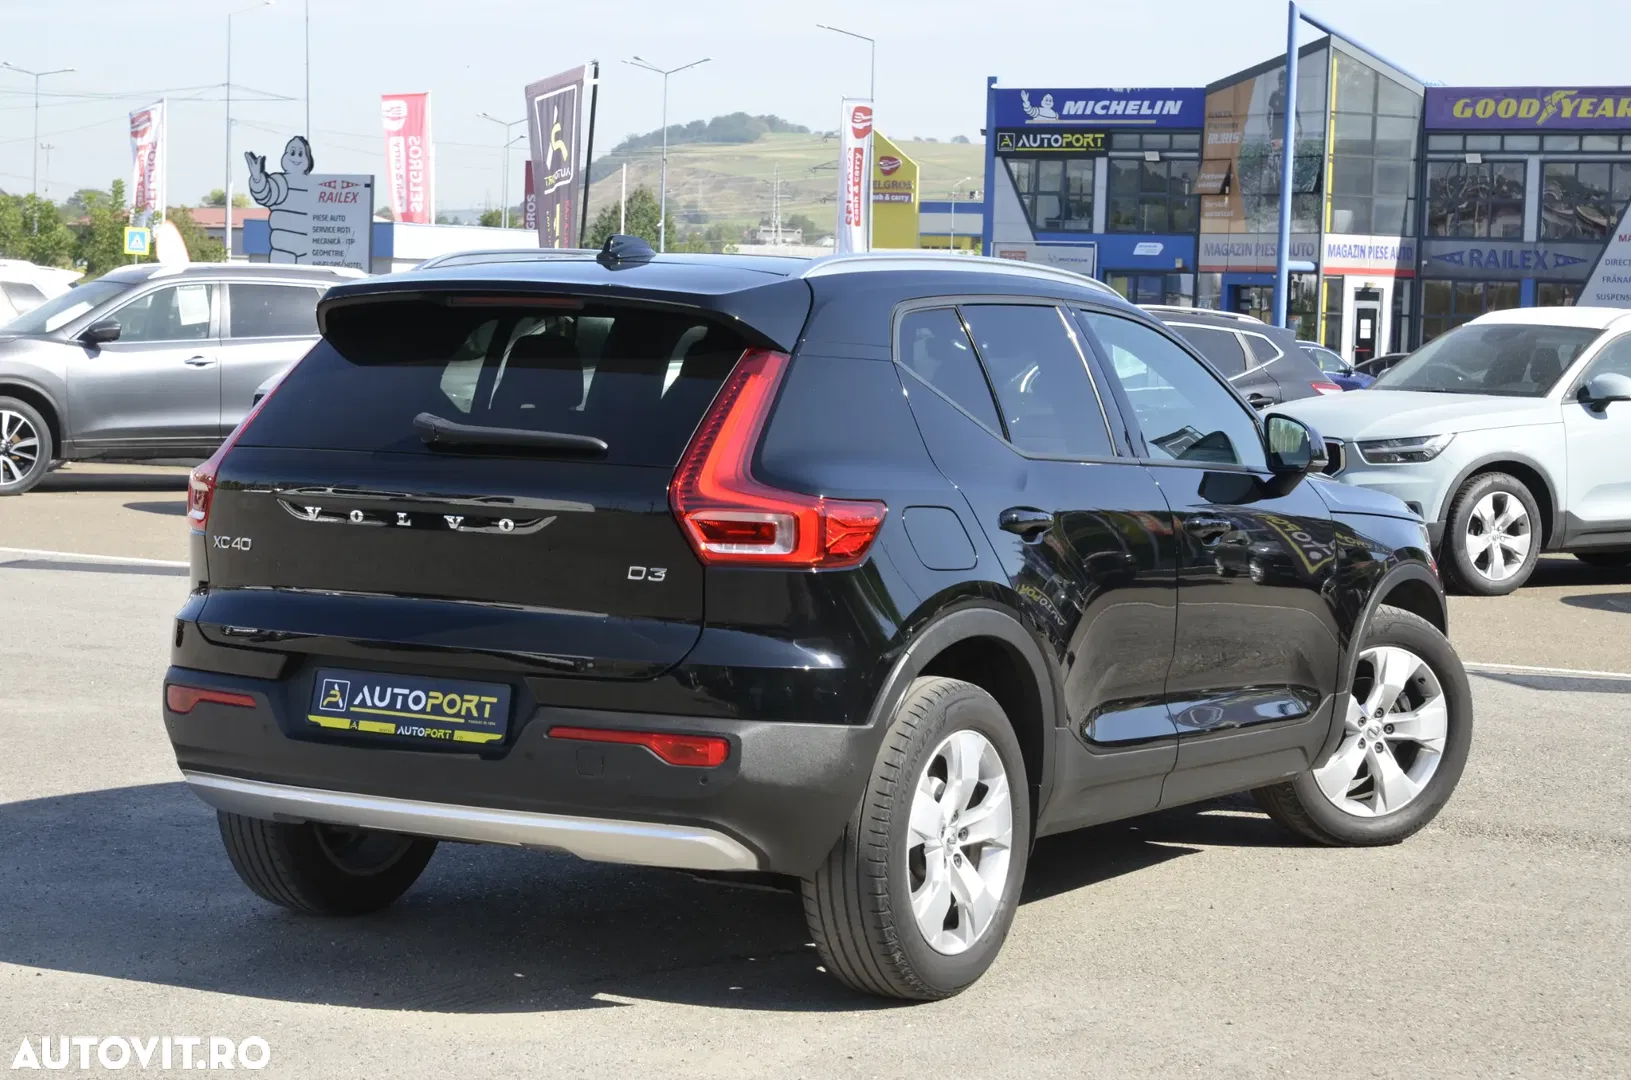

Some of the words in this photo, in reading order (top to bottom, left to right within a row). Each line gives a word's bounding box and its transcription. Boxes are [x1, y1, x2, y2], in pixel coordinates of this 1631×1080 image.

[1062, 100, 1183, 115] MICHELIN
[1017, 133, 1105, 147] AUTOPORT
[854, 153, 862, 182] carry
[318, 191, 360, 204] RAILEX
[891, 194, 910, 202] carry
[312, 249, 344, 257] GEOMETRIE
[1203, 242, 1252, 257] MAGAZIN
[1255, 243, 1277, 257] PIES
[1328, 244, 1366, 258] MAGAZIN
[1368, 245, 1388, 259] PIESE
[1390, 246, 1413, 260] AUTO
[1469, 248, 1548, 270] RAILEX
[304, 506, 516, 532] VOLVO
[213, 535, 252, 550] XC40
[627, 566, 668, 581] D3
[353, 685, 498, 718] AUTOPORT
[397, 726, 452, 739] AUTOPORT
